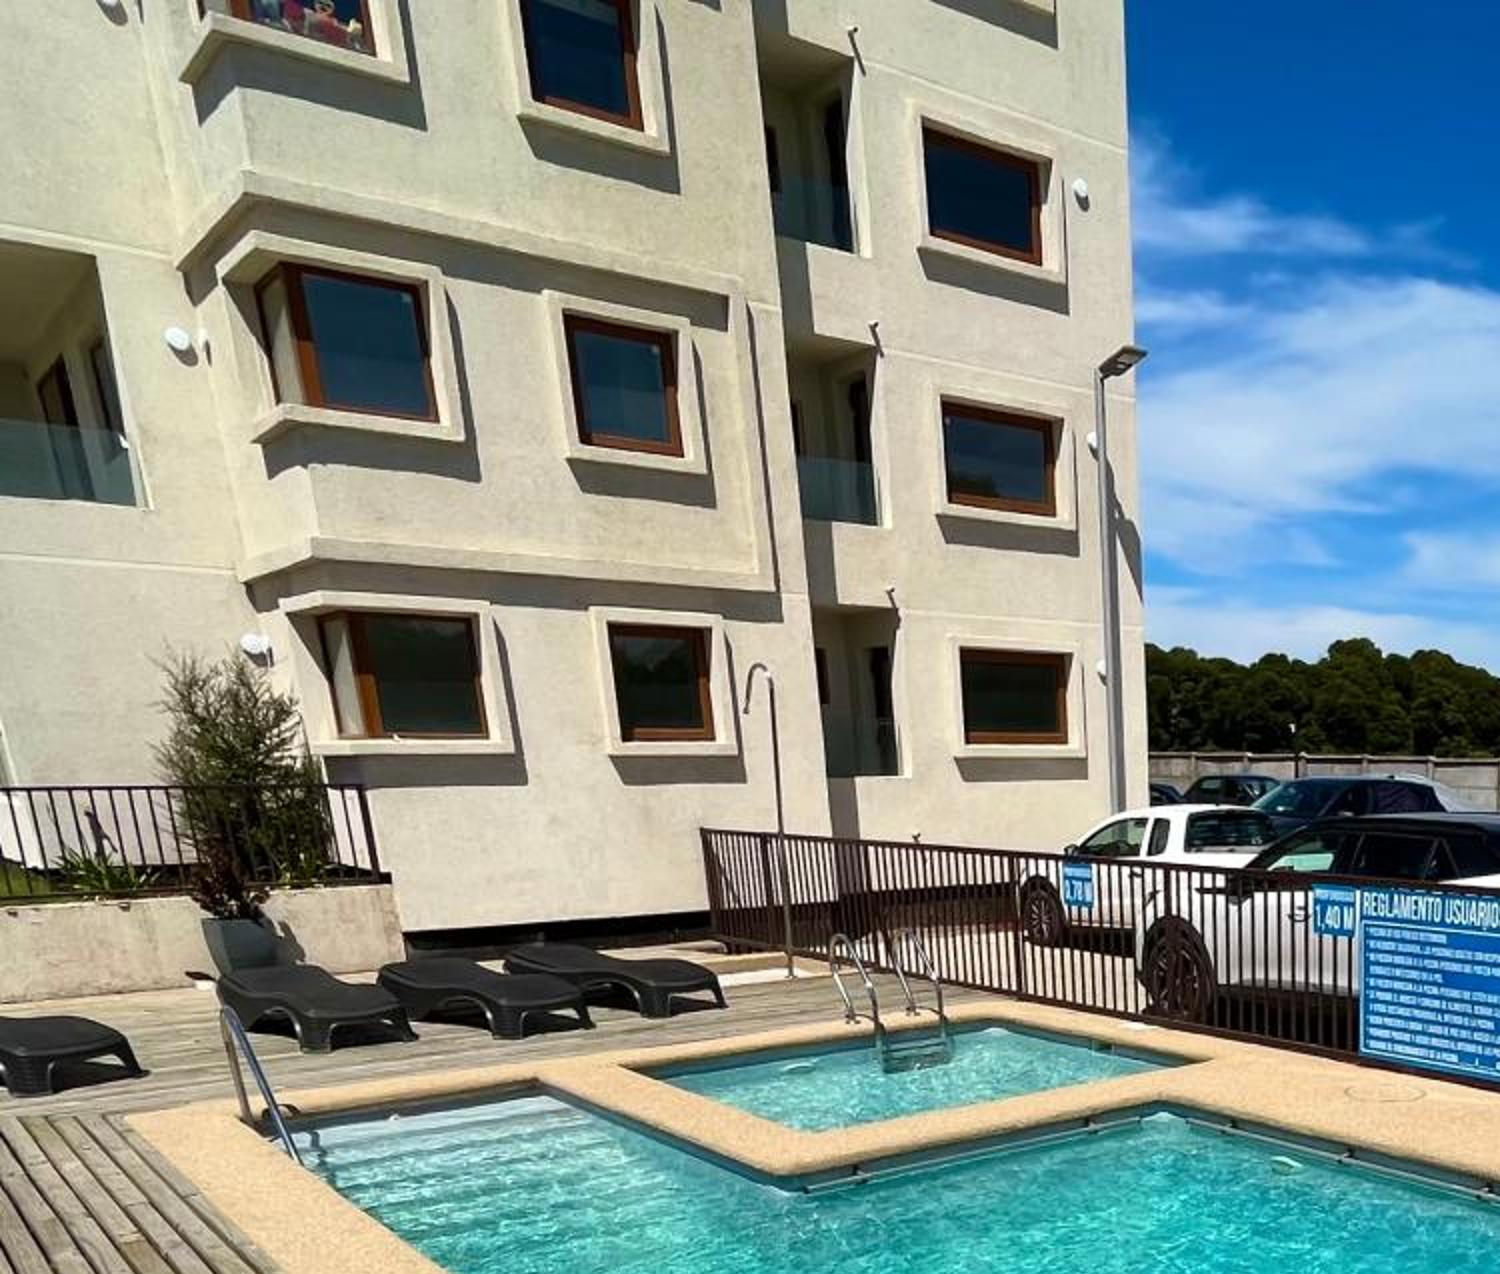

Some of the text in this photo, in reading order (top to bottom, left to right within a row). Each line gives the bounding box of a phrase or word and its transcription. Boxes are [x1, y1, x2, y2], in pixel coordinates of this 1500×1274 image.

[1315, 904, 1354, 931] 1,40 M
[1362, 891, 1441, 923] REGLAMENTO
